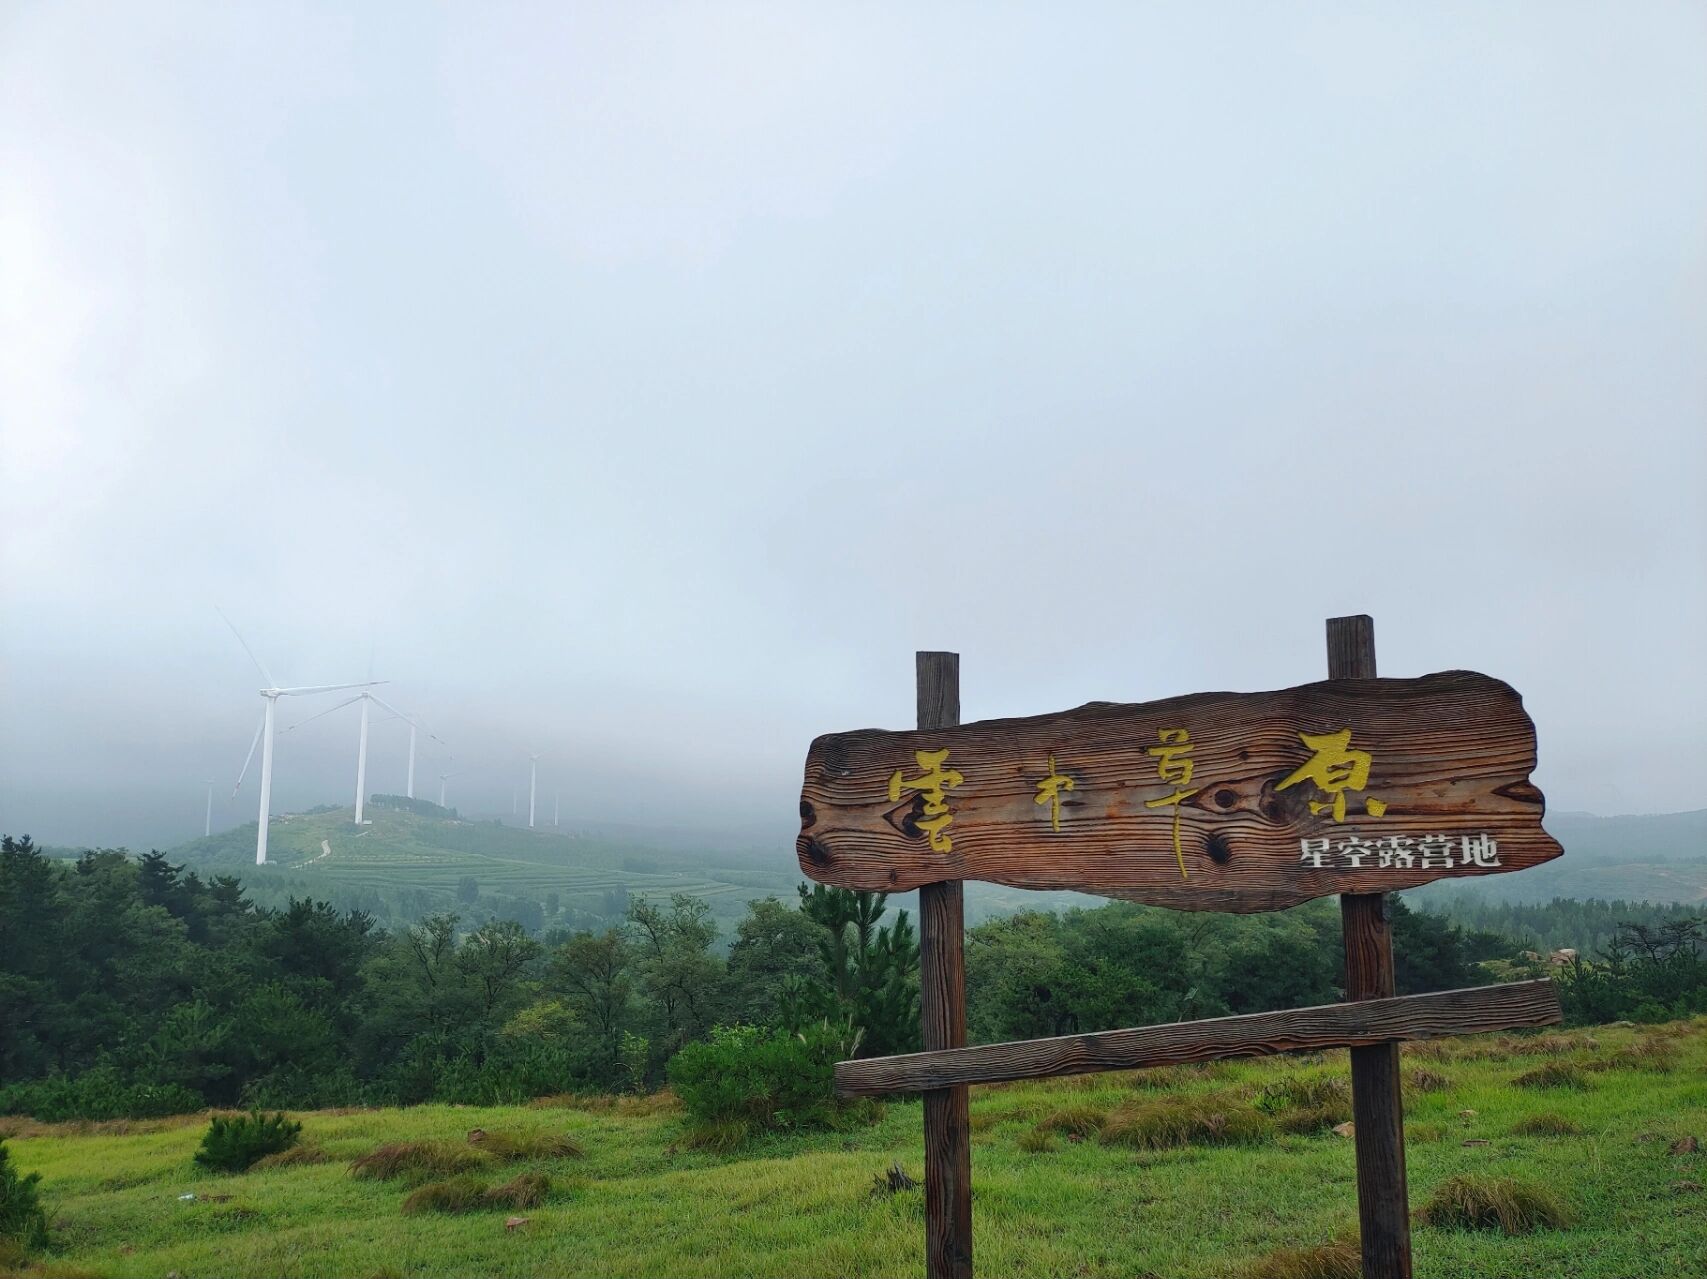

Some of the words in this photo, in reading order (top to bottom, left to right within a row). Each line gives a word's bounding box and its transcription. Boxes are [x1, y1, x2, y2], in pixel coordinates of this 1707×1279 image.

[1299, 833, 1502, 868] 星空露营地
